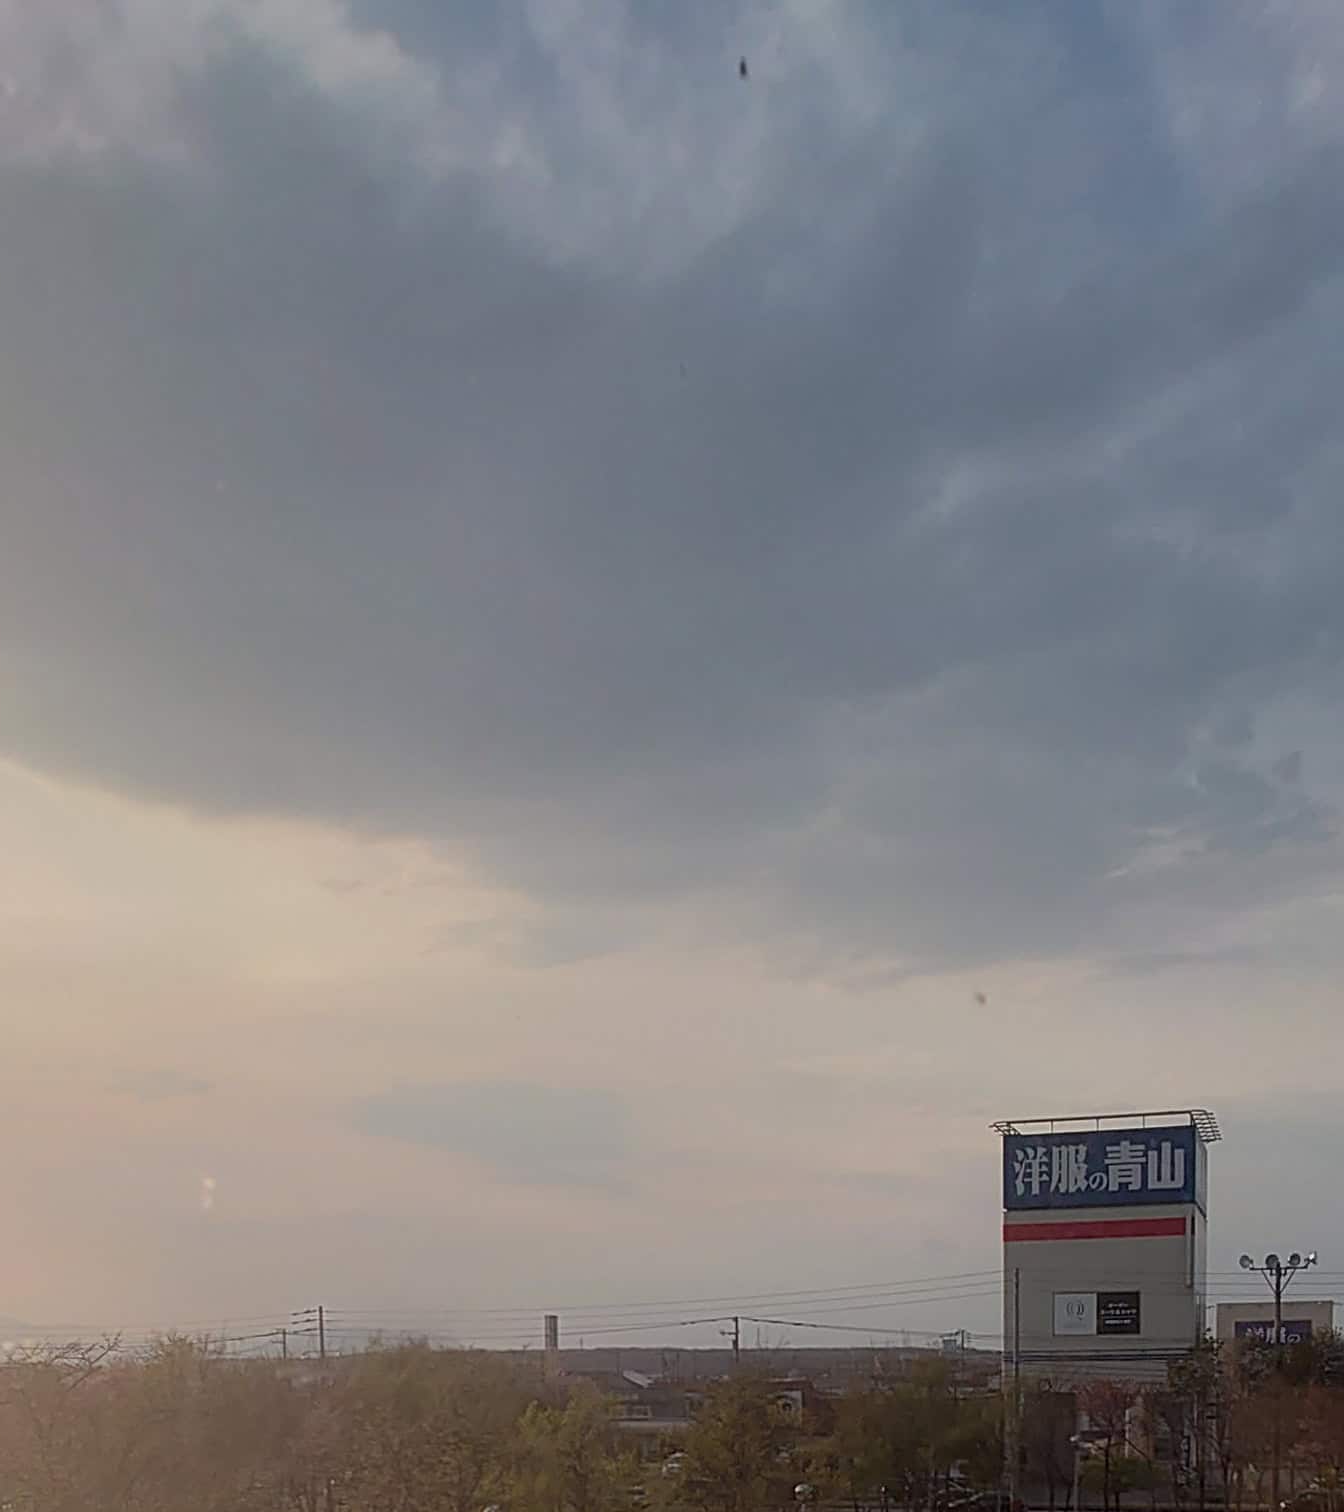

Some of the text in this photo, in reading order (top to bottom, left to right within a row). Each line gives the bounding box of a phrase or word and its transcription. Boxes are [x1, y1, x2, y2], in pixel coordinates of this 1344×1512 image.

[1014, 1140, 1186, 1196] 洋服の青山
